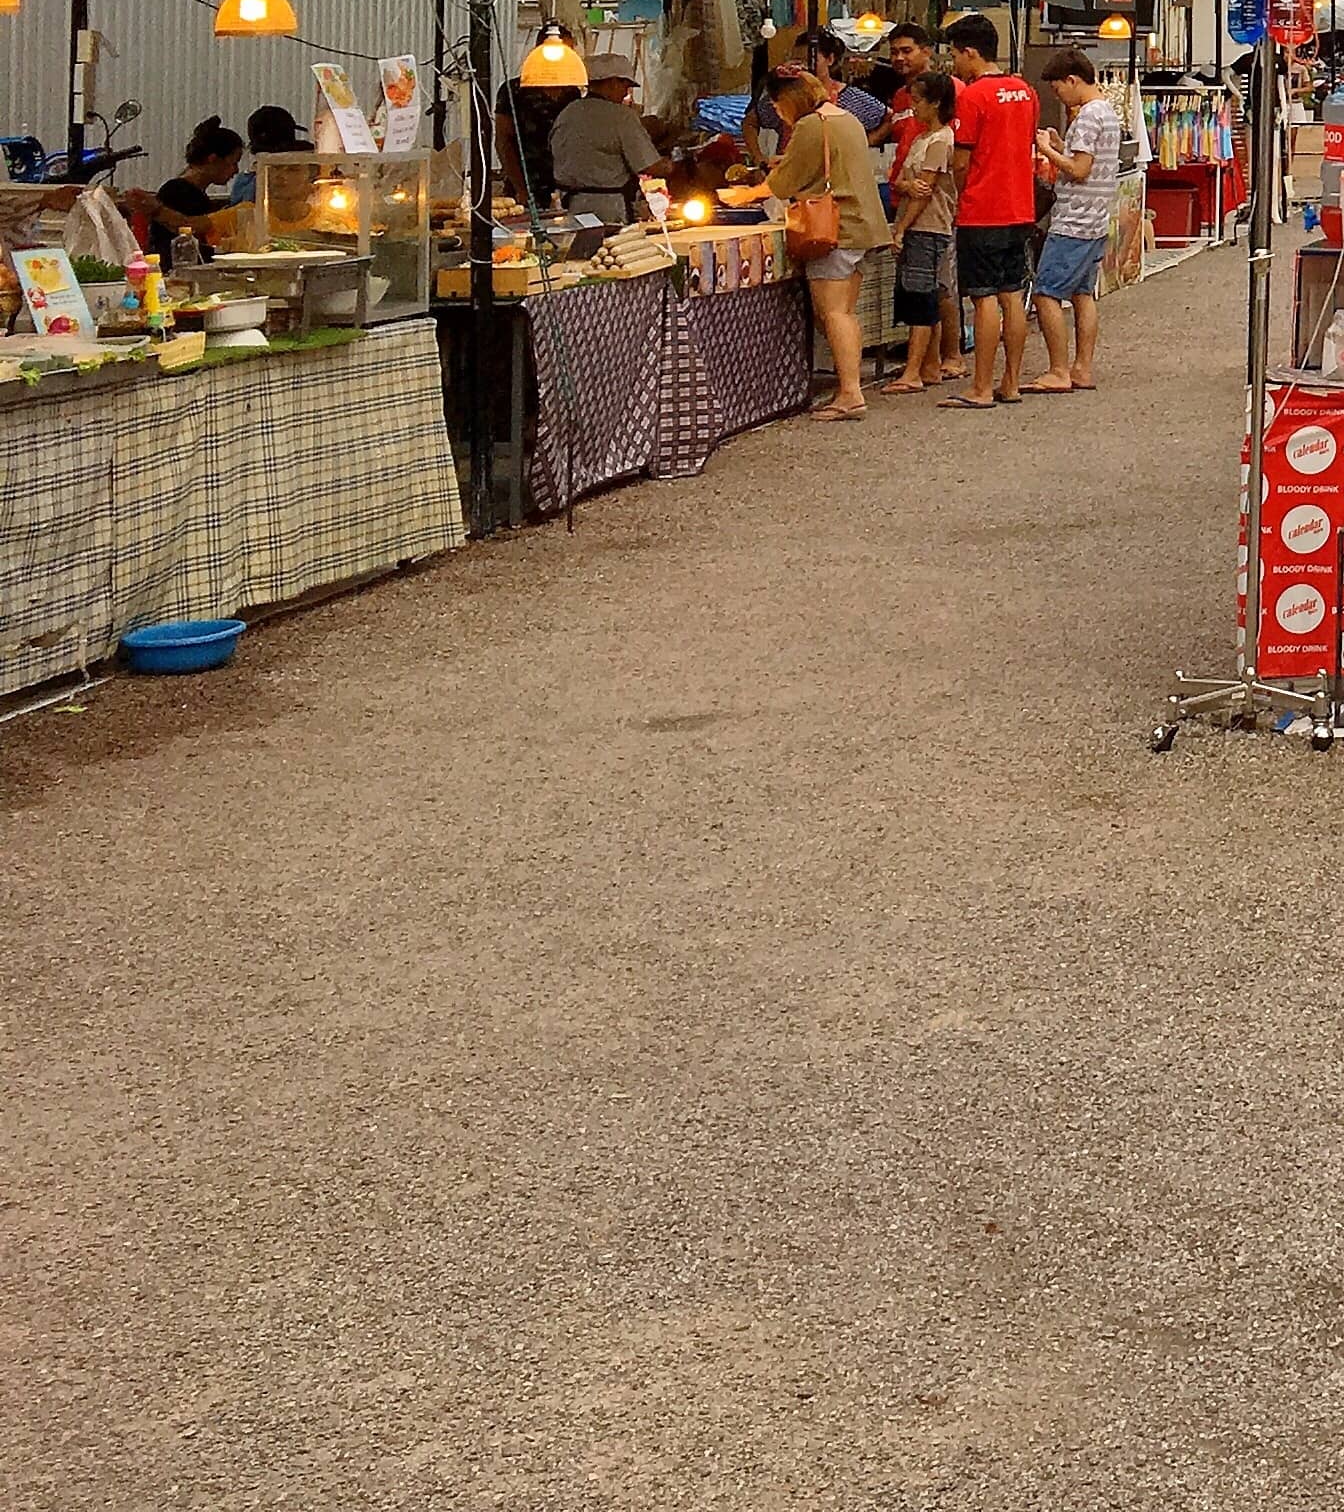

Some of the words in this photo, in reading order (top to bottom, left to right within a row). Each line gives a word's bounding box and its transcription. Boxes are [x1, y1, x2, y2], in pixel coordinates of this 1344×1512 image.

[1278, 485, 1311, 494] BLOODY
[1273, 565, 1305, 574] BLOODY
[1267, 645, 1300, 654] BLOODY
